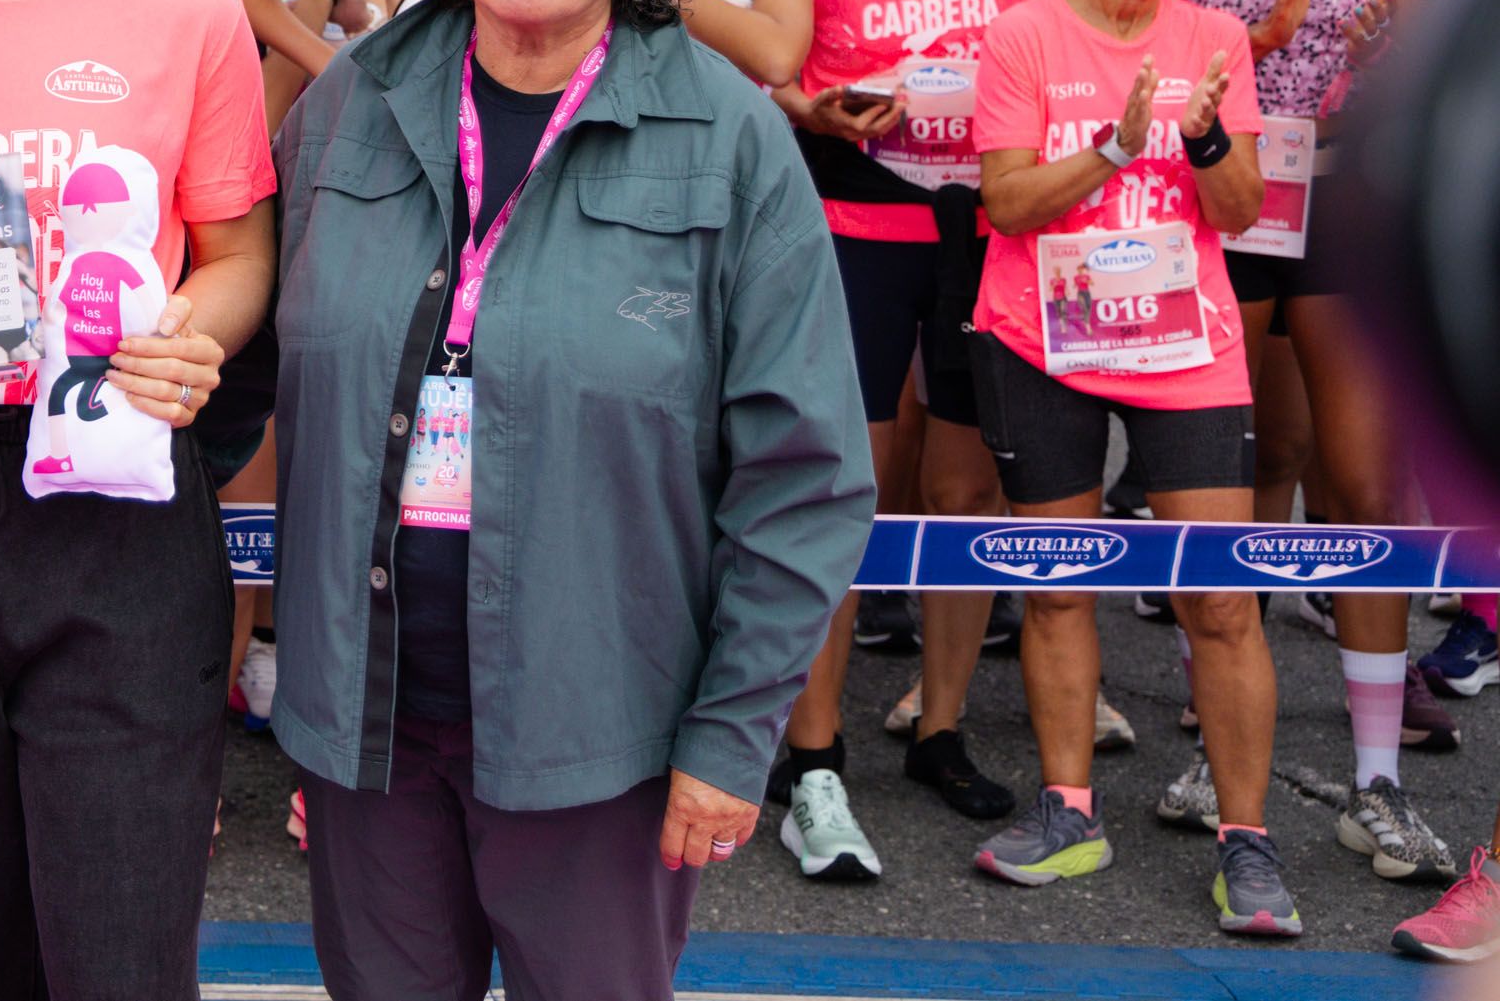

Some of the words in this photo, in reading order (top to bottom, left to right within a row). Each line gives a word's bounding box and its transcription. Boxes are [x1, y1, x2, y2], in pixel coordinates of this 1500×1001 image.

[51, 73, 124, 96] ASTURIANA
[910, 118, 967, 140] 016
[1092, 253, 1153, 267] ASTURIANA
[81, 273, 103, 289] Hoy
[71, 288, 114, 303] GANAN
[83, 305, 101, 318] las
[1096, 295, 1159, 323] 016
[73, 320, 113, 335] chicas
[1119, 325, 1142, 337] 565
[438, 465, 455, 478] 20
[983, 537, 1114, 560] ASTURIANA
[1246, 537, 1377, 560] ASTURIANA
